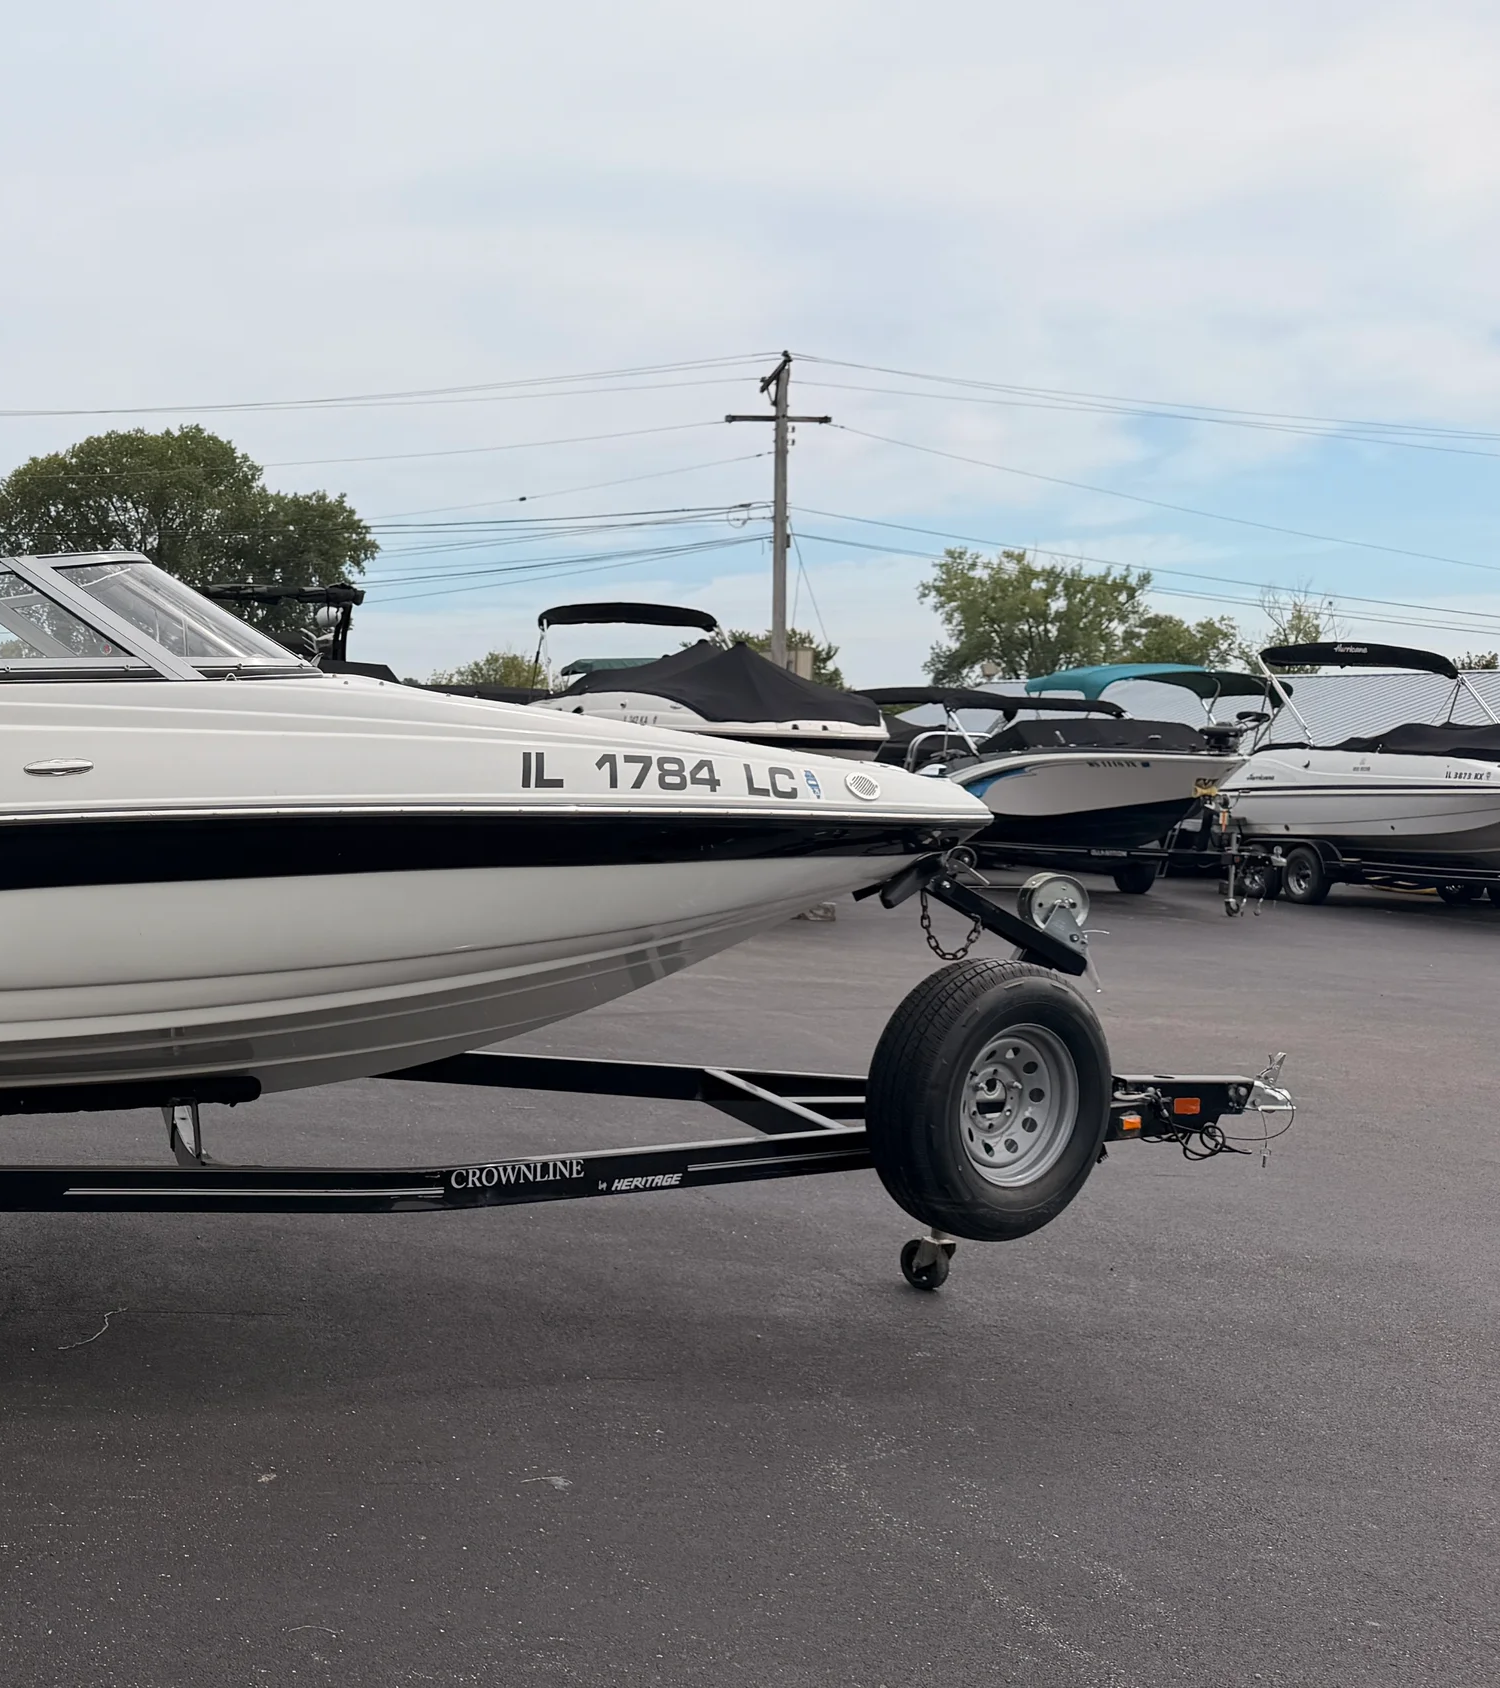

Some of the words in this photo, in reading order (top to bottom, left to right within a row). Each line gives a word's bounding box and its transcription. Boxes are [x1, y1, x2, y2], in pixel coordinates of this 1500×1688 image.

[521, 751, 564, 789] IL
[595, 753, 721, 793] 1784
[743, 763, 798, 799] LC
[450, 1159, 585, 1189] CROWNLINE
[611, 1173, 683, 1191] HERITAGE
